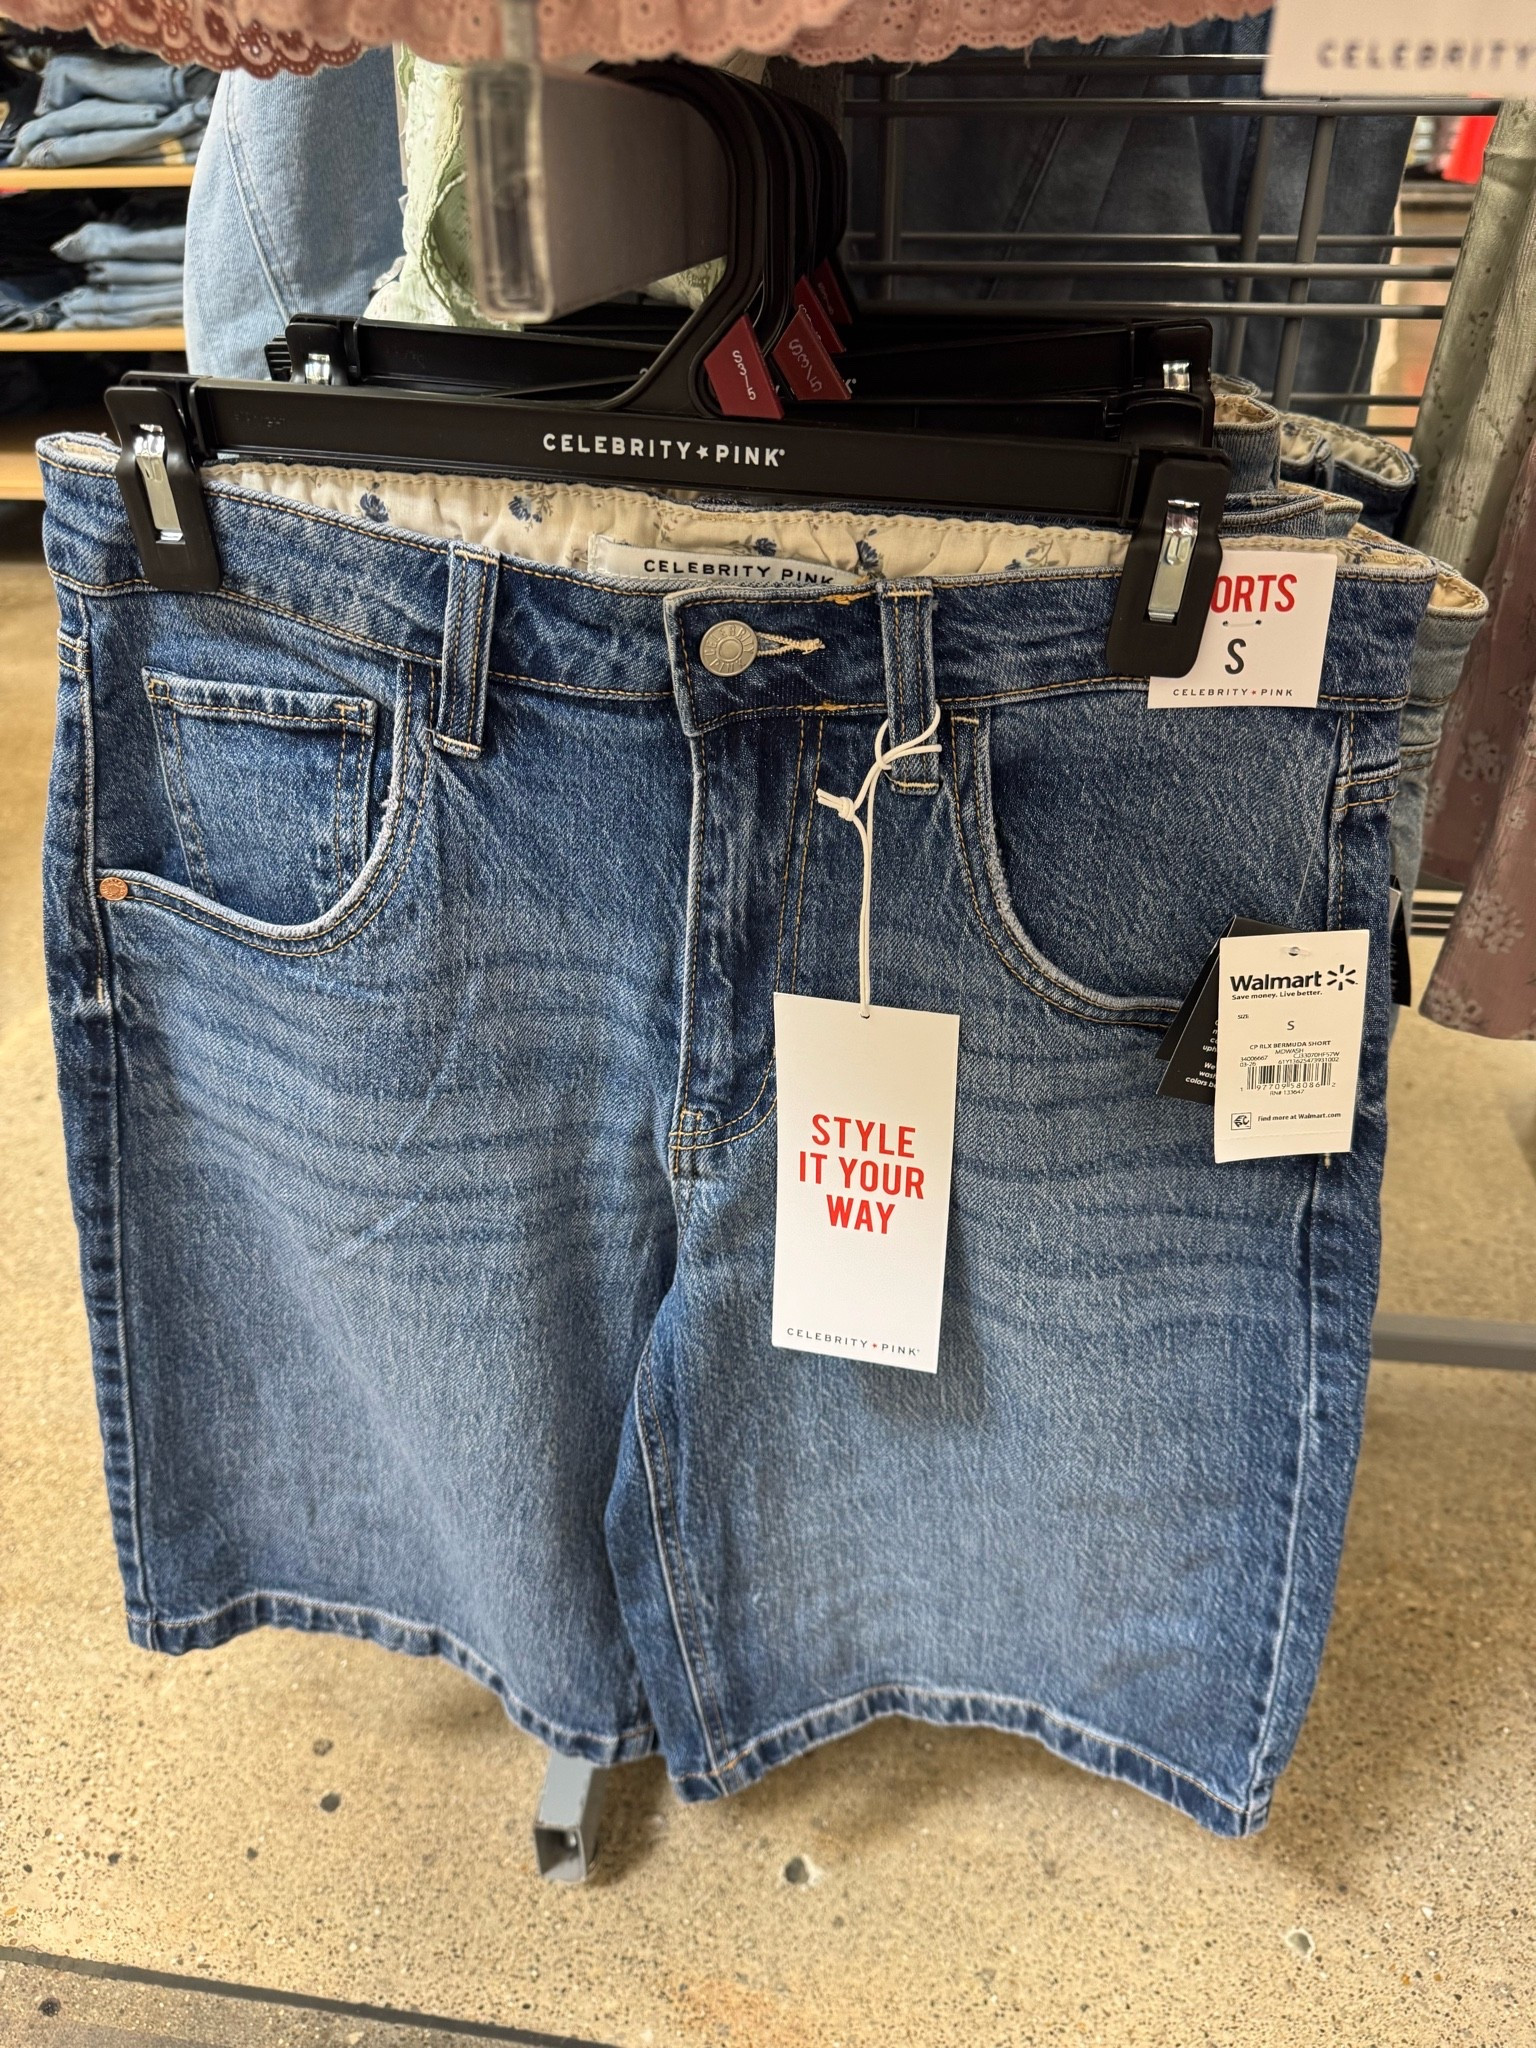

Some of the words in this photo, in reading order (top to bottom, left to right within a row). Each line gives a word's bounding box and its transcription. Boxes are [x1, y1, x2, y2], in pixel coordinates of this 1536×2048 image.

[1316, 36, 1536, 71] CELEBRITY
[543, 433, 691, 460] CELEBRITY
[643, 559, 771, 578] CELEBRITY
[781, 569, 834, 584] PINK
[1211, 573, 1298, 613] ORTS
[1224, 638, 1247, 675] S
[1173, 688, 1249, 697] CELEBRITY
[1261, 688, 1294, 697] PINK
[1230, 970, 1322, 992] Walmart
[1251, 992, 1278, 1000] money.
[1286, 1020, 1295, 1031] S
[1273, 1041, 1307, 1049] BERMUDA
[1204, 1062, 1216, 1070] We
[1185, 1076, 1208, 1087] colors
[1298, 1112, 1342, 1120] Walmart.com
[811, 1113, 916, 1159] STYLE
[799, 1150, 828, 1185] IT
[838, 1156, 925, 1200] YOUR
[826, 1194, 896, 1235] WAY
[786, 1327, 868, 1348] CELEBRITY
[881, 1343, 917, 1356] PINK
